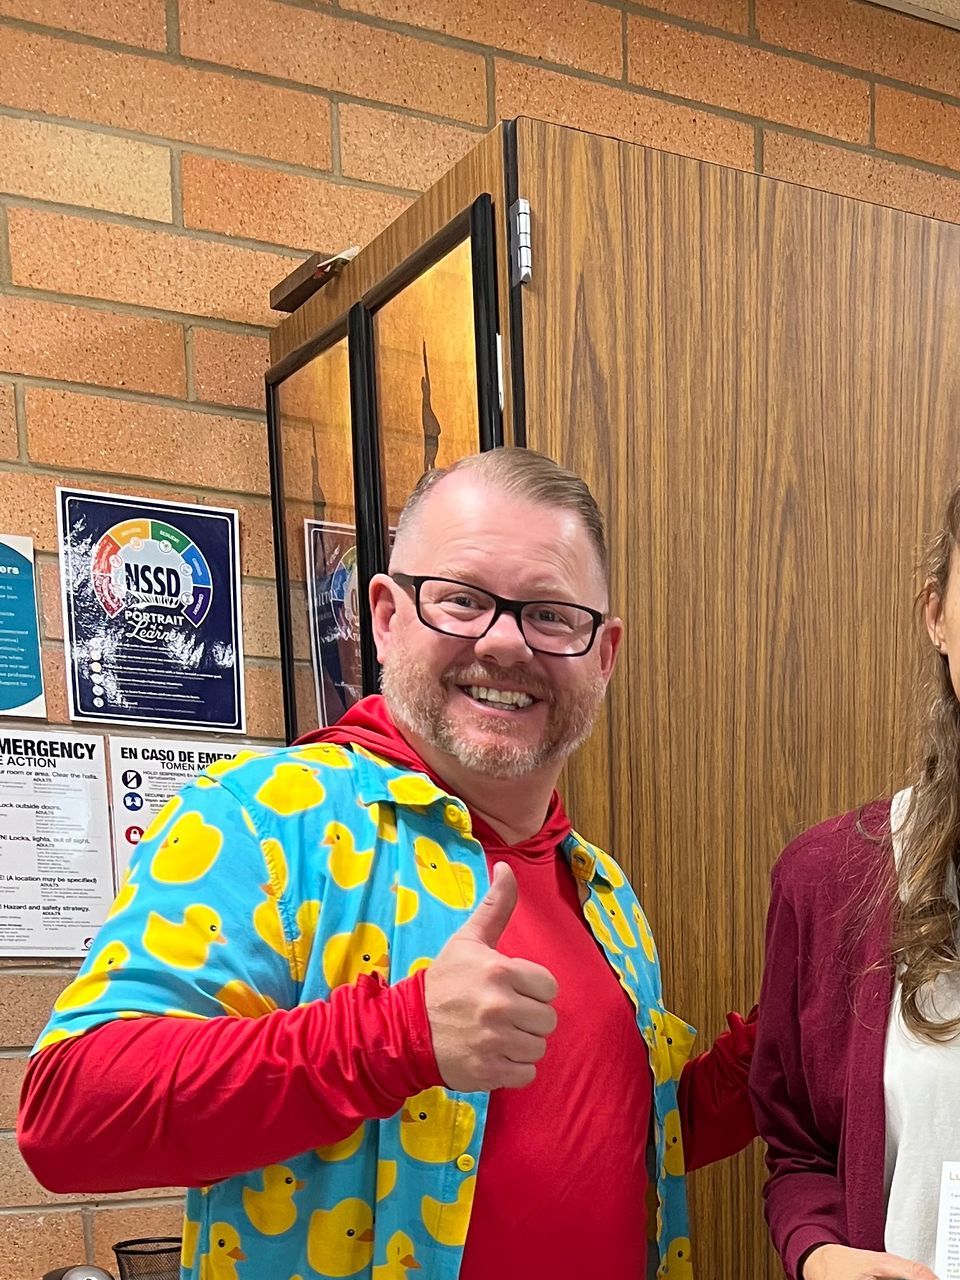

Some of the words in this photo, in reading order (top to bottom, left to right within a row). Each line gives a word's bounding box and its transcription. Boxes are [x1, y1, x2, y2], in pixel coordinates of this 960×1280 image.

[124, 562, 181, 598] NSSD
[124, 610, 184, 626] PORTRAIT
[6, 755, 56, 769] ACTION
[120, 747, 138, 760] EN
[141, 748, 175, 761] CASO
[180, 750, 195, 763] DE
[160, 762, 195, 771] TOMEN
[9, 834, 31, 842] Locks,
[32, 835, 52, 843] lights,
